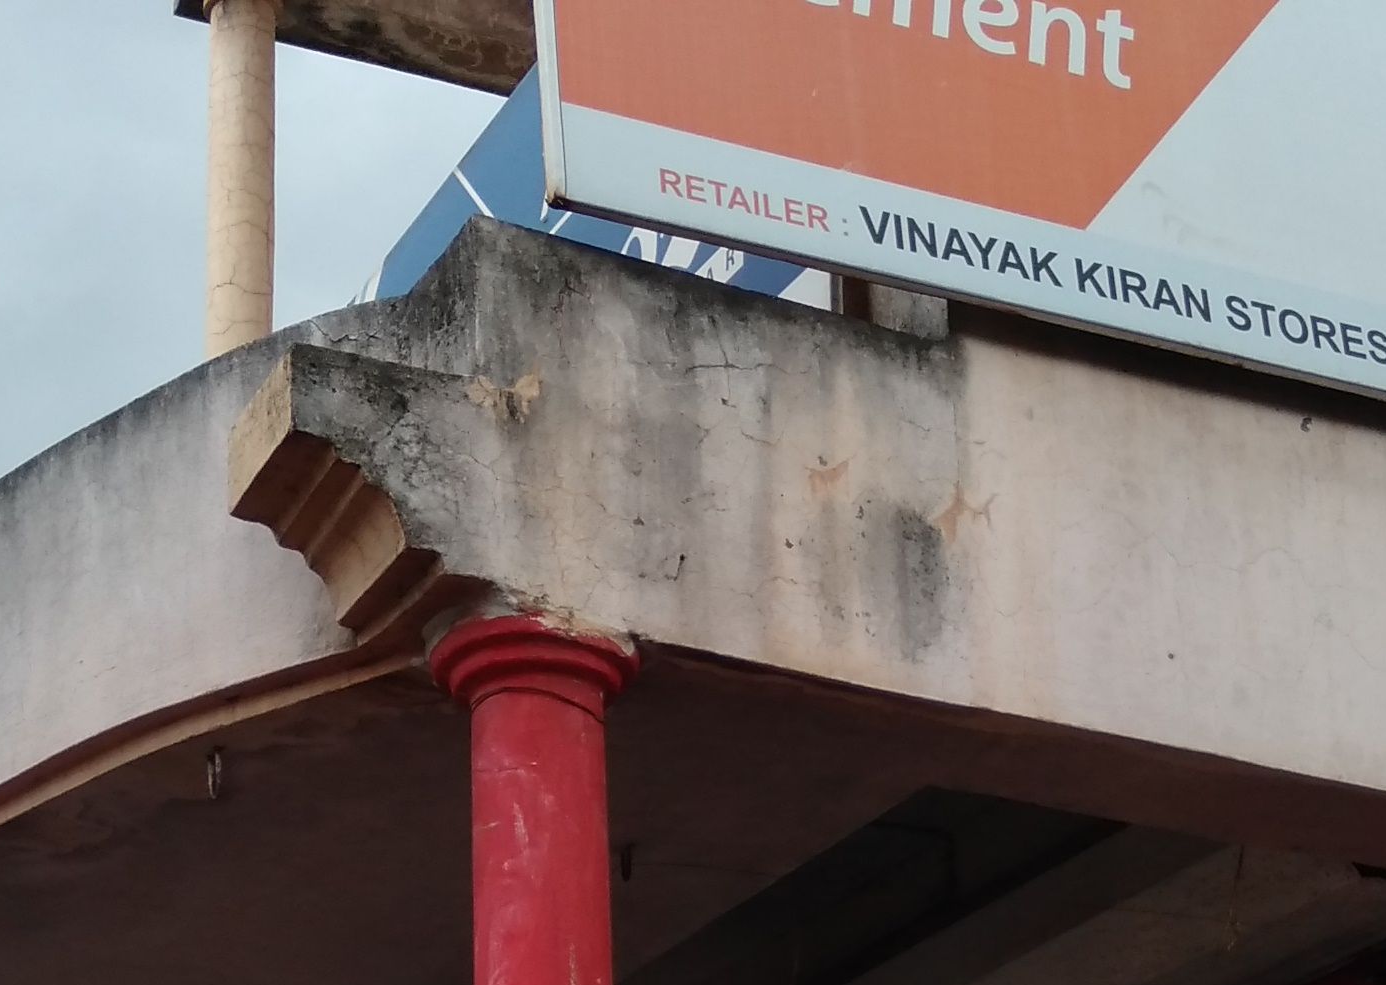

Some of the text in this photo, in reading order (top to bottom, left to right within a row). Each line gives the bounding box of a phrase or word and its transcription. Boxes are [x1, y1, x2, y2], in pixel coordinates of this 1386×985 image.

[659, 168, 830, 232] RETAILER
[859, 205, 1063, 288] VINAYAK
[1074, 258, 1213, 323] KIRAN
